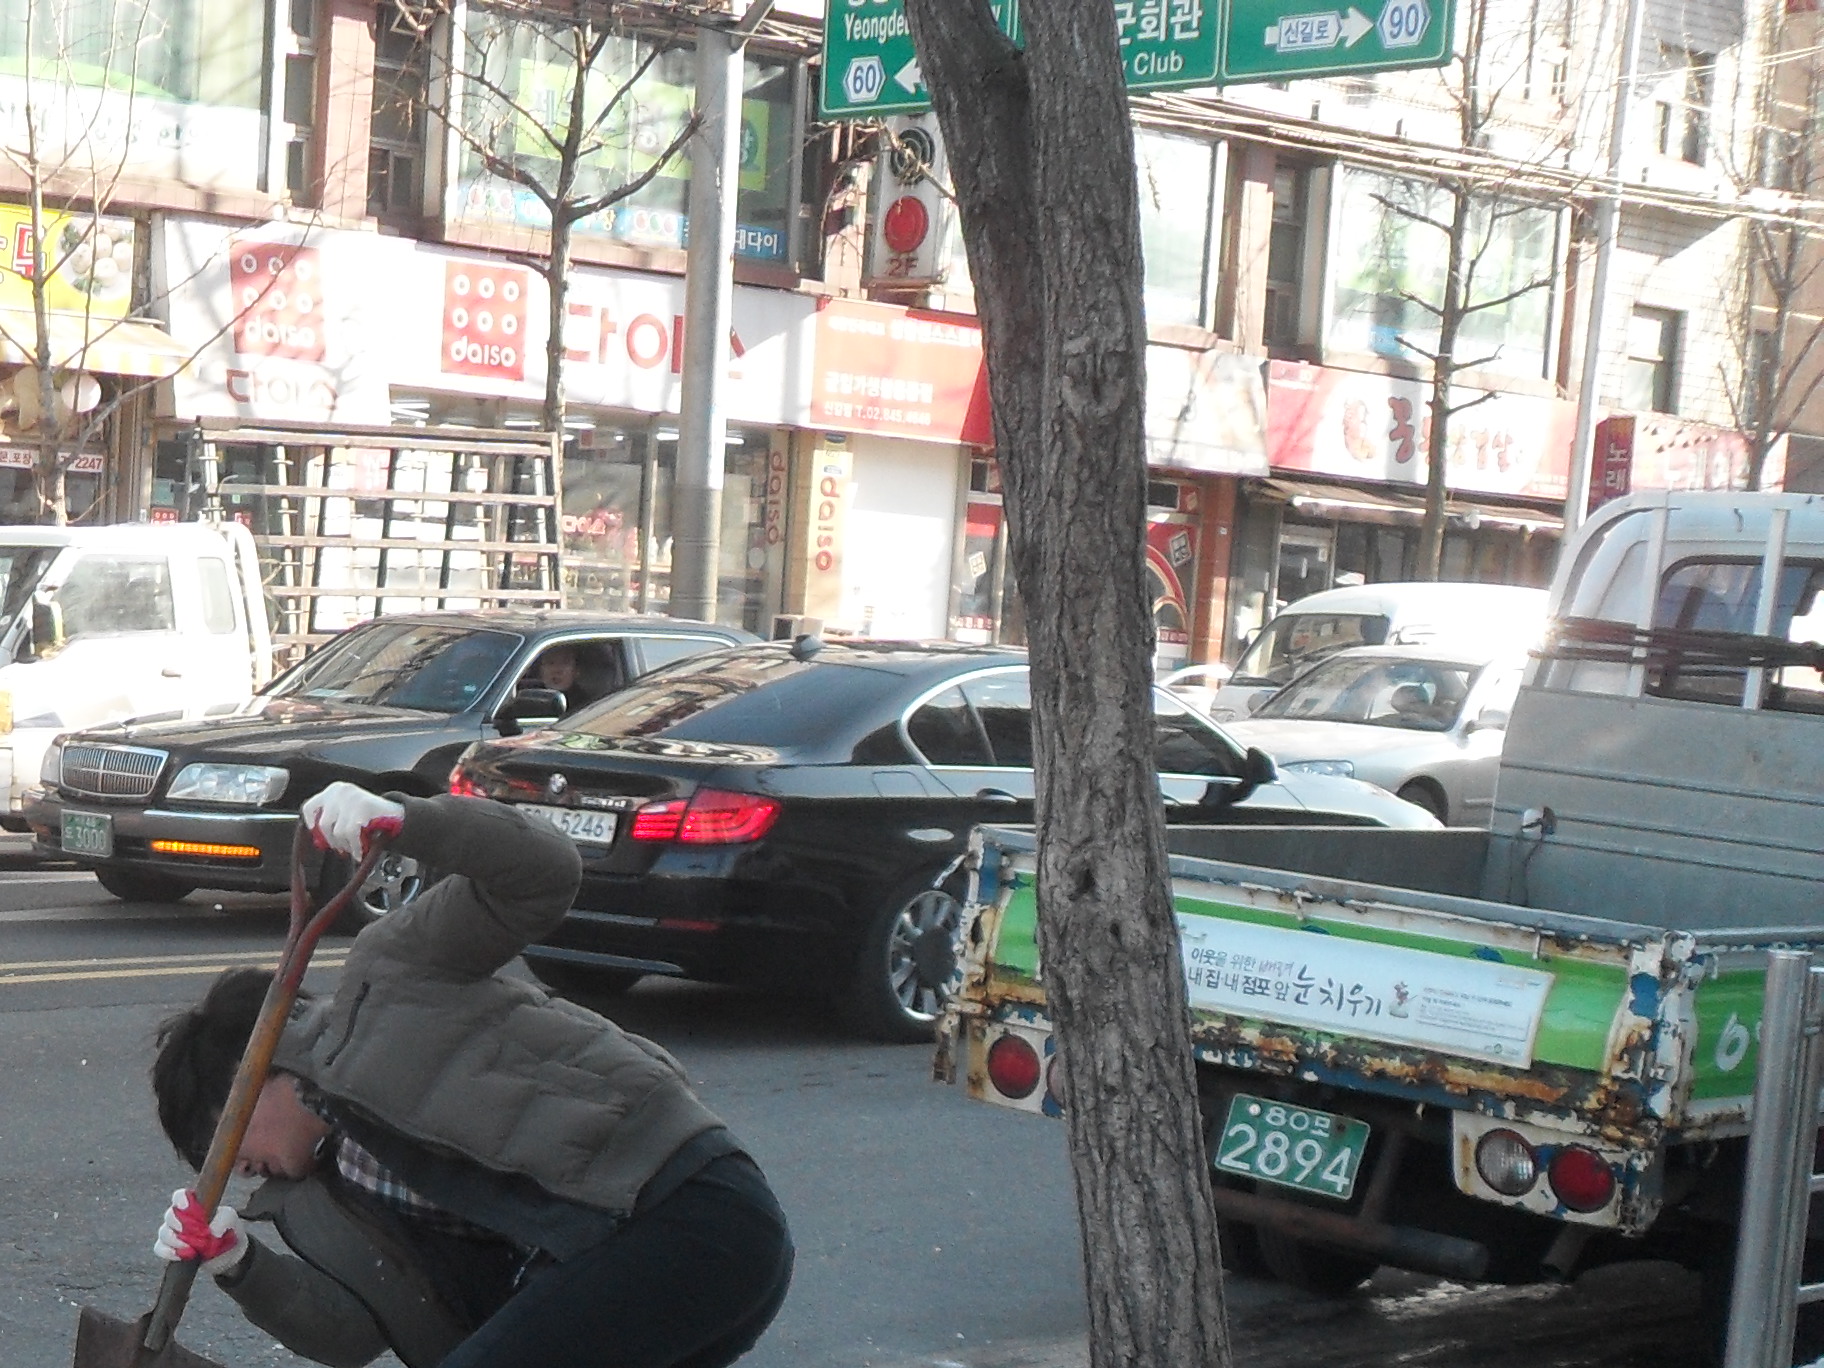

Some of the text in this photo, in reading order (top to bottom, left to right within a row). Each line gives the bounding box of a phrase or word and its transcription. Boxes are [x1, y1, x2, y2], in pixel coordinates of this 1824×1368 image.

[1284, 19, 1330, 44] 신길로
[1389, 4, 1420, 40] 90
[1134, 50, 1184, 75] Club
[852, 64, 877, 95] 60
[887, 256, 919, 277] 2F
[245, 316, 316, 349] daiso
[451, 335, 516, 368] daiso
[768, 450, 785, 545] daiso
[815, 475, 841, 571] daiso
[560, 811, 605, 837] 5246
[1191, 947, 1228, 968] 이웃을
[1229, 953, 1256, 972] 위한
[1242, 975, 1272, 997] 점포
[1292, 964, 1316, 1006] 눈
[1319, 977, 1382, 1017] 치우기
[1220, 1123, 1353, 1193] 2894
